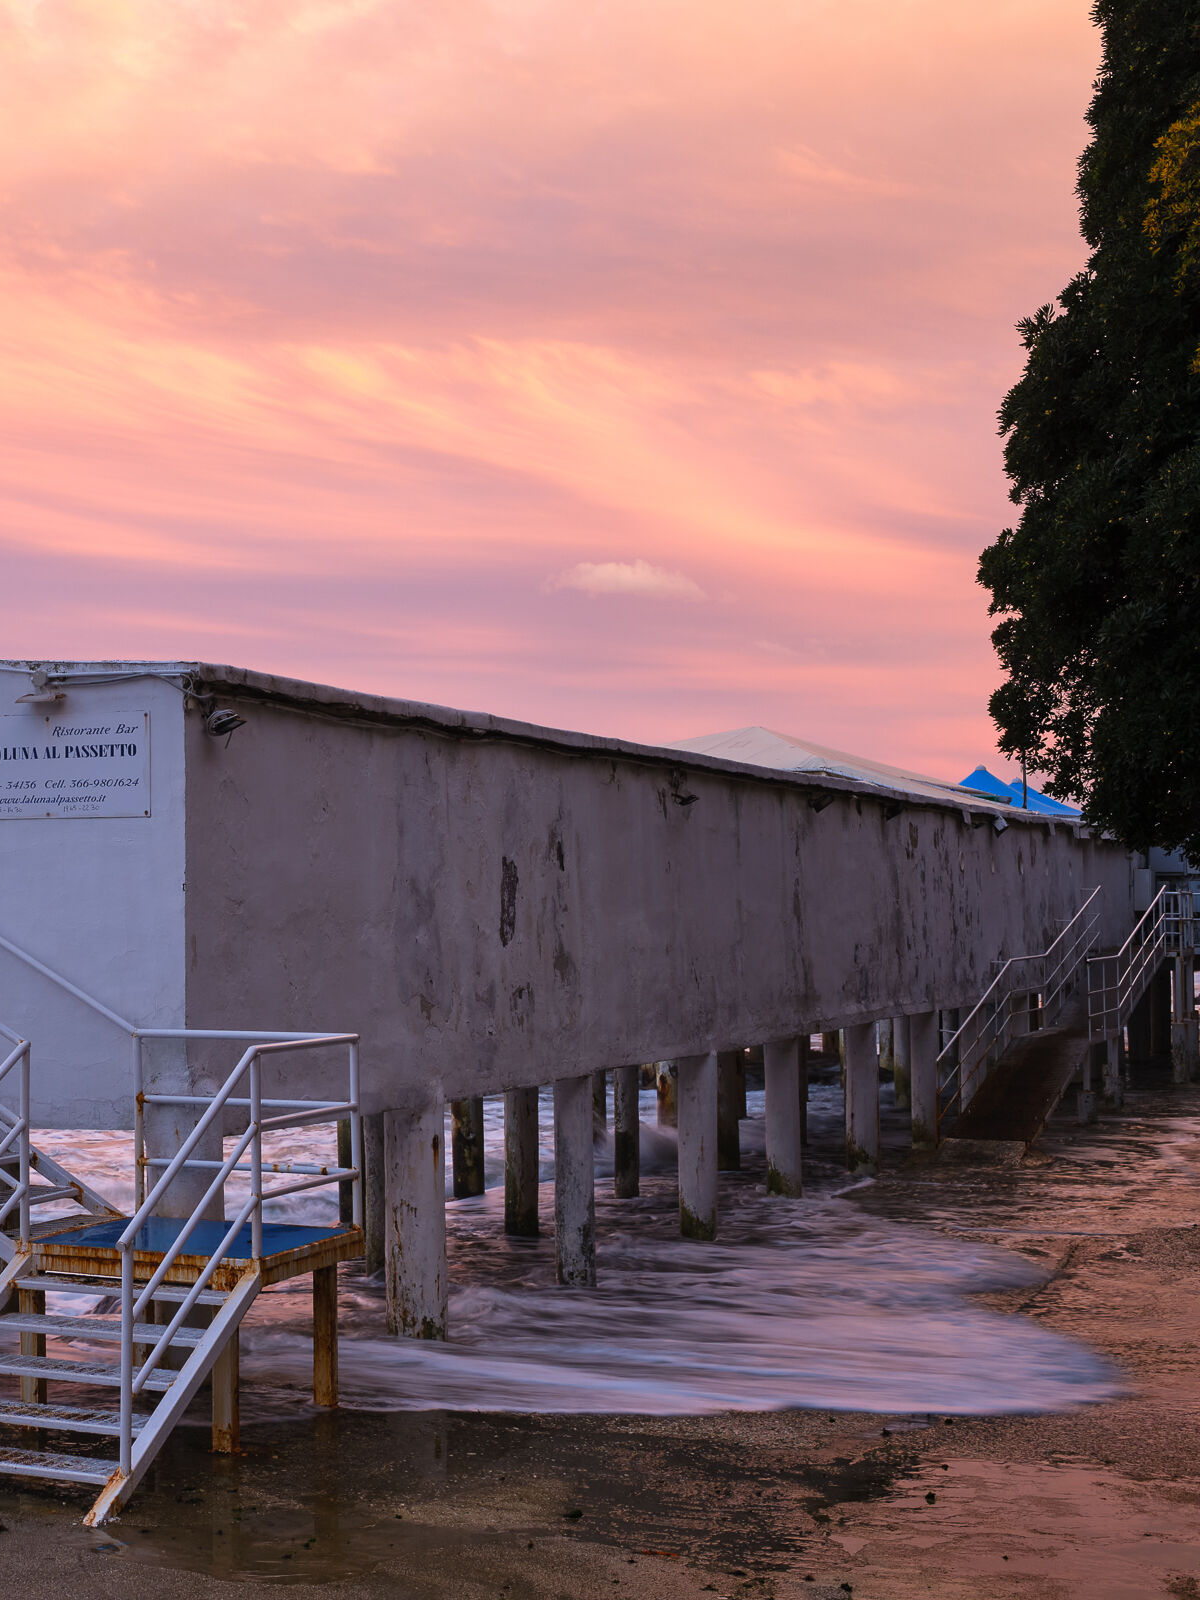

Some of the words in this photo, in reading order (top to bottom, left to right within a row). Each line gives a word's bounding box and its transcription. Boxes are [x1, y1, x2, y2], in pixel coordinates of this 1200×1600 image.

[52, 726, 111, 737] Ristorante
[115, 723, 139, 734] Bar
[3, 746, 39, 761] LUNA
[43, 746, 60, 759] AL
[65, 743, 137, 759] PASSETTO
[44, 779, 67, 789] Cell.
[69, 778, 140, 788] 366-9801624
